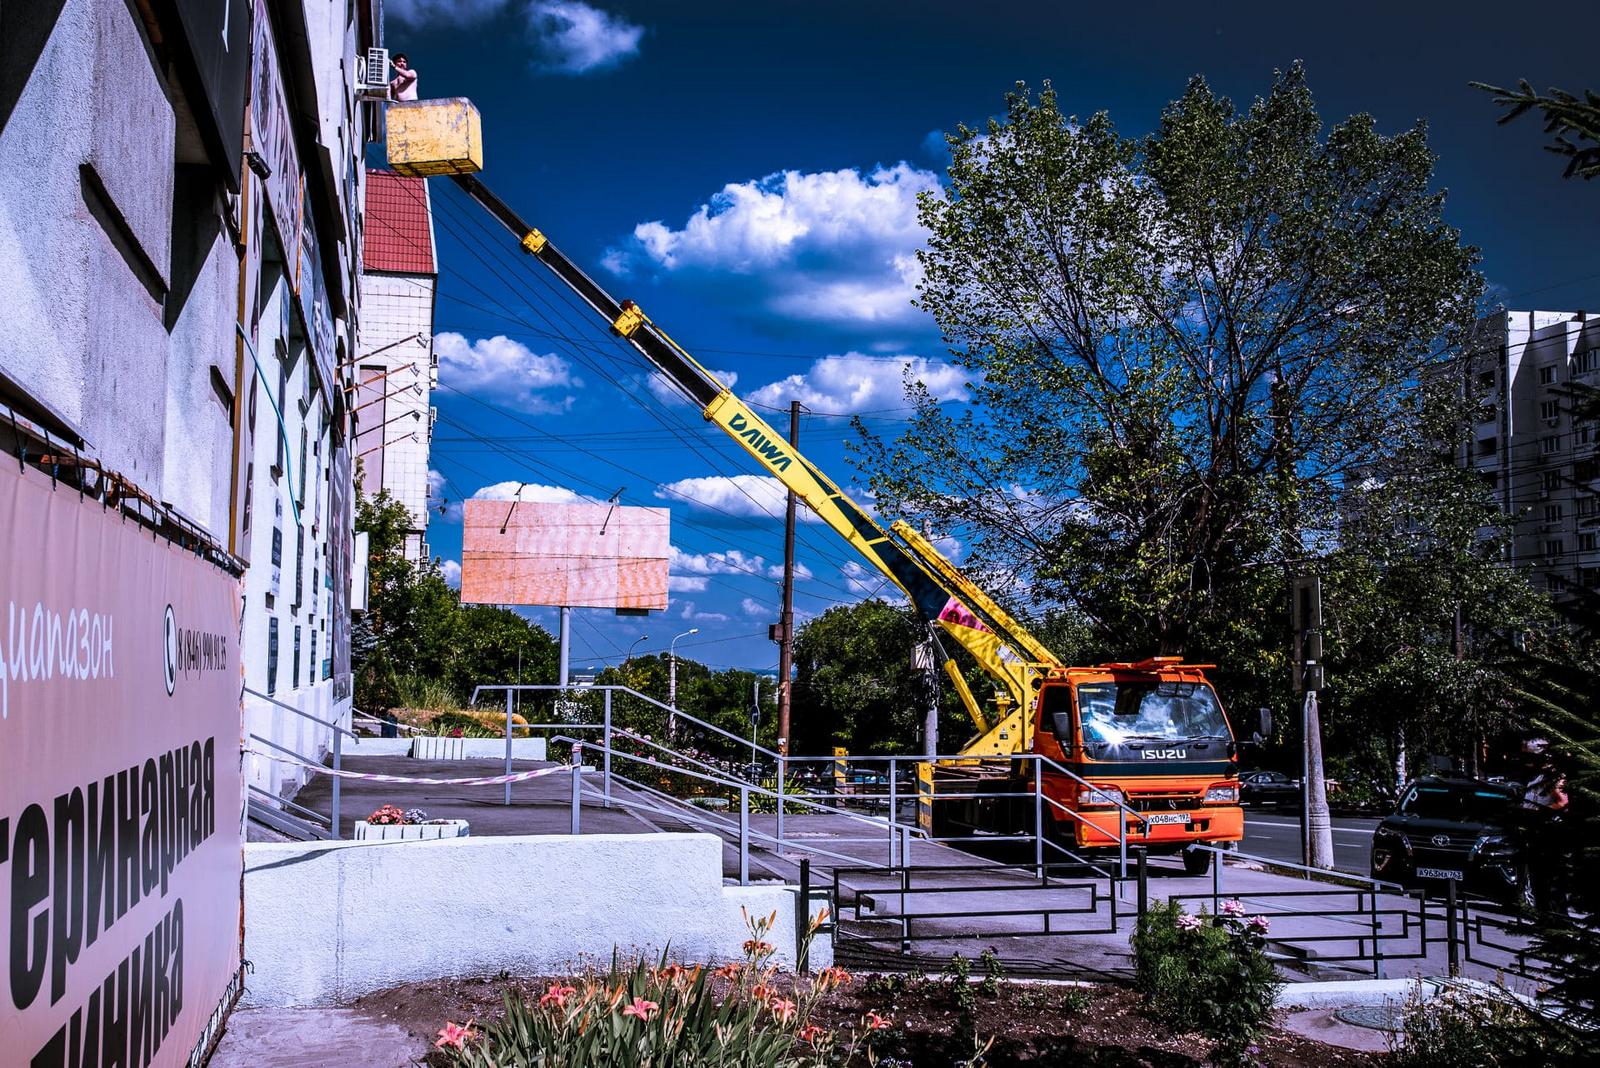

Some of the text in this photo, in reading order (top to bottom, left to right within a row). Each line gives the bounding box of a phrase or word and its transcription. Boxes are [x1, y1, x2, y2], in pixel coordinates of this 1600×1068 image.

[728, 412, 792, 473] DAIWA
[0, 600, 114, 720] иапазон
[1141, 749, 1187, 760] ISUZU
